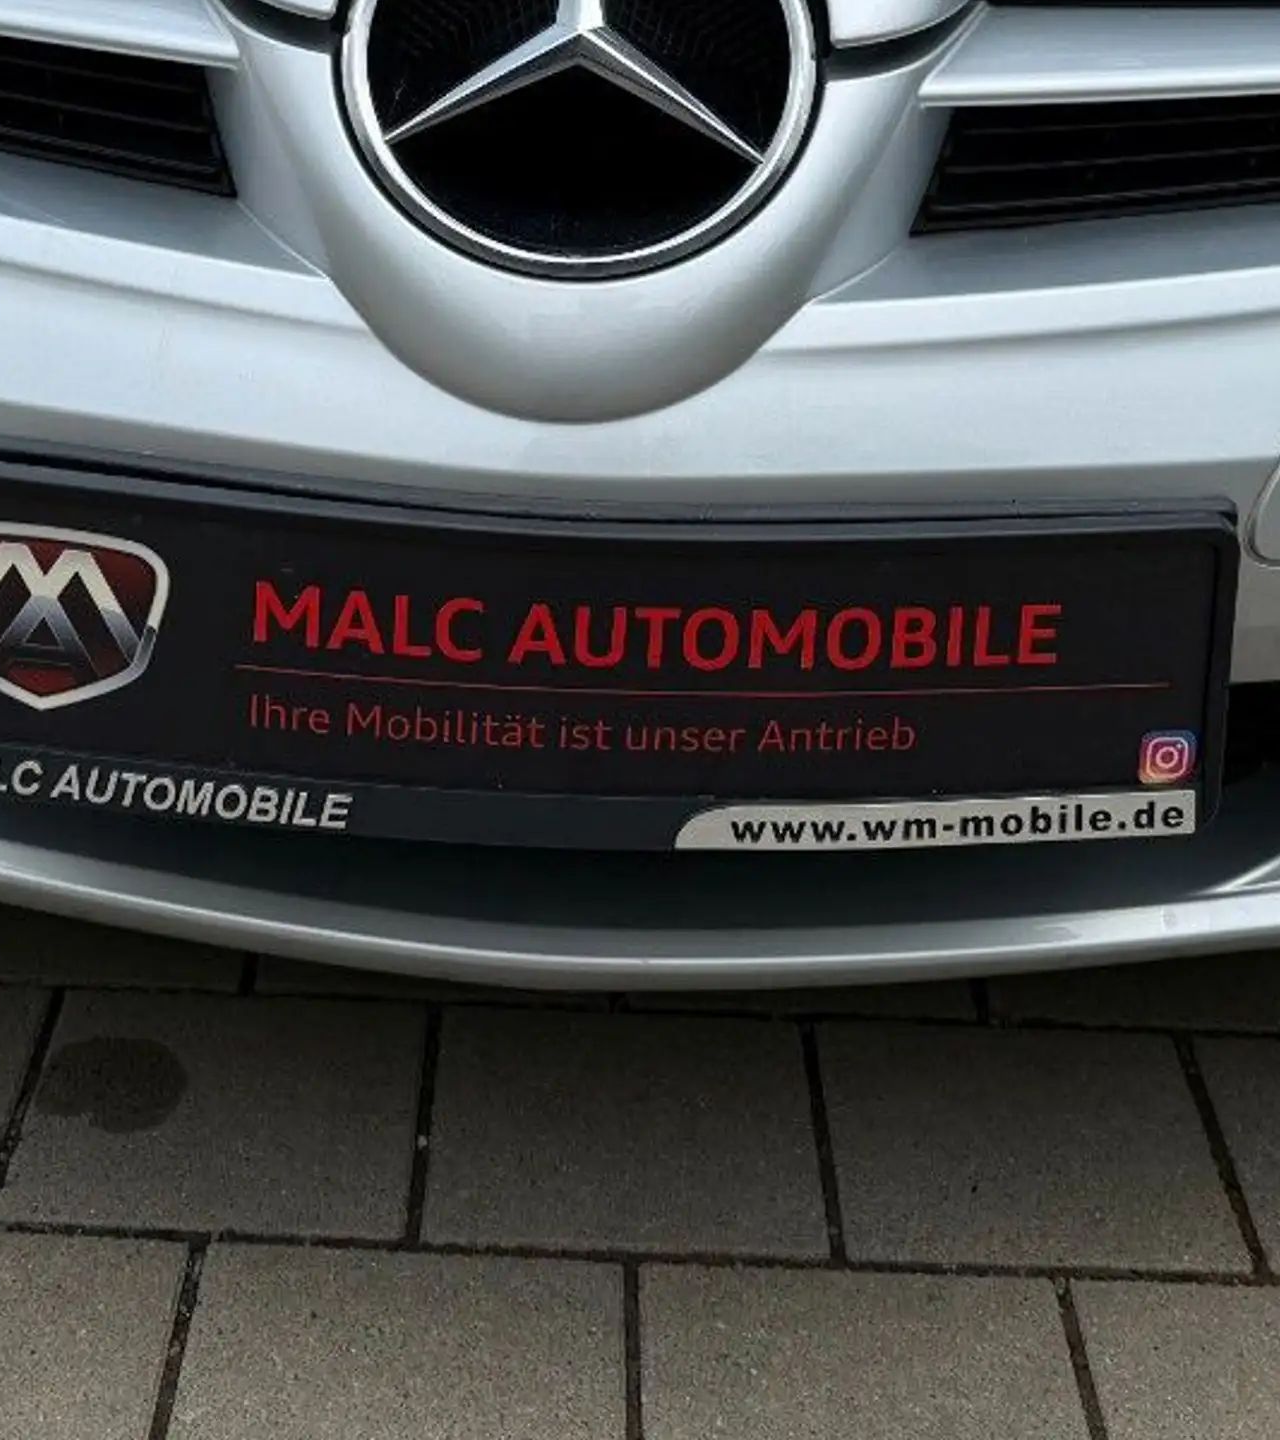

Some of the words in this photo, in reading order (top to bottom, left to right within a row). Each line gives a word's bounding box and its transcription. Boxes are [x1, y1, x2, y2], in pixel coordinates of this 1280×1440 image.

[253, 580, 486, 664] MALC
[508, 603, 1063, 672] AUTOMOBILE
[248, 692, 329, 734] Ihre
[346, 701, 545, 748] Mobilität
[559, 716, 613, 751] ist
[624, 726, 746, 753] unser
[757, 716, 916, 753] Antrieb
[50, 765, 354, 830] AUTOMOBILE
[729, 799, 1186, 845] www.wm-mobile.de
